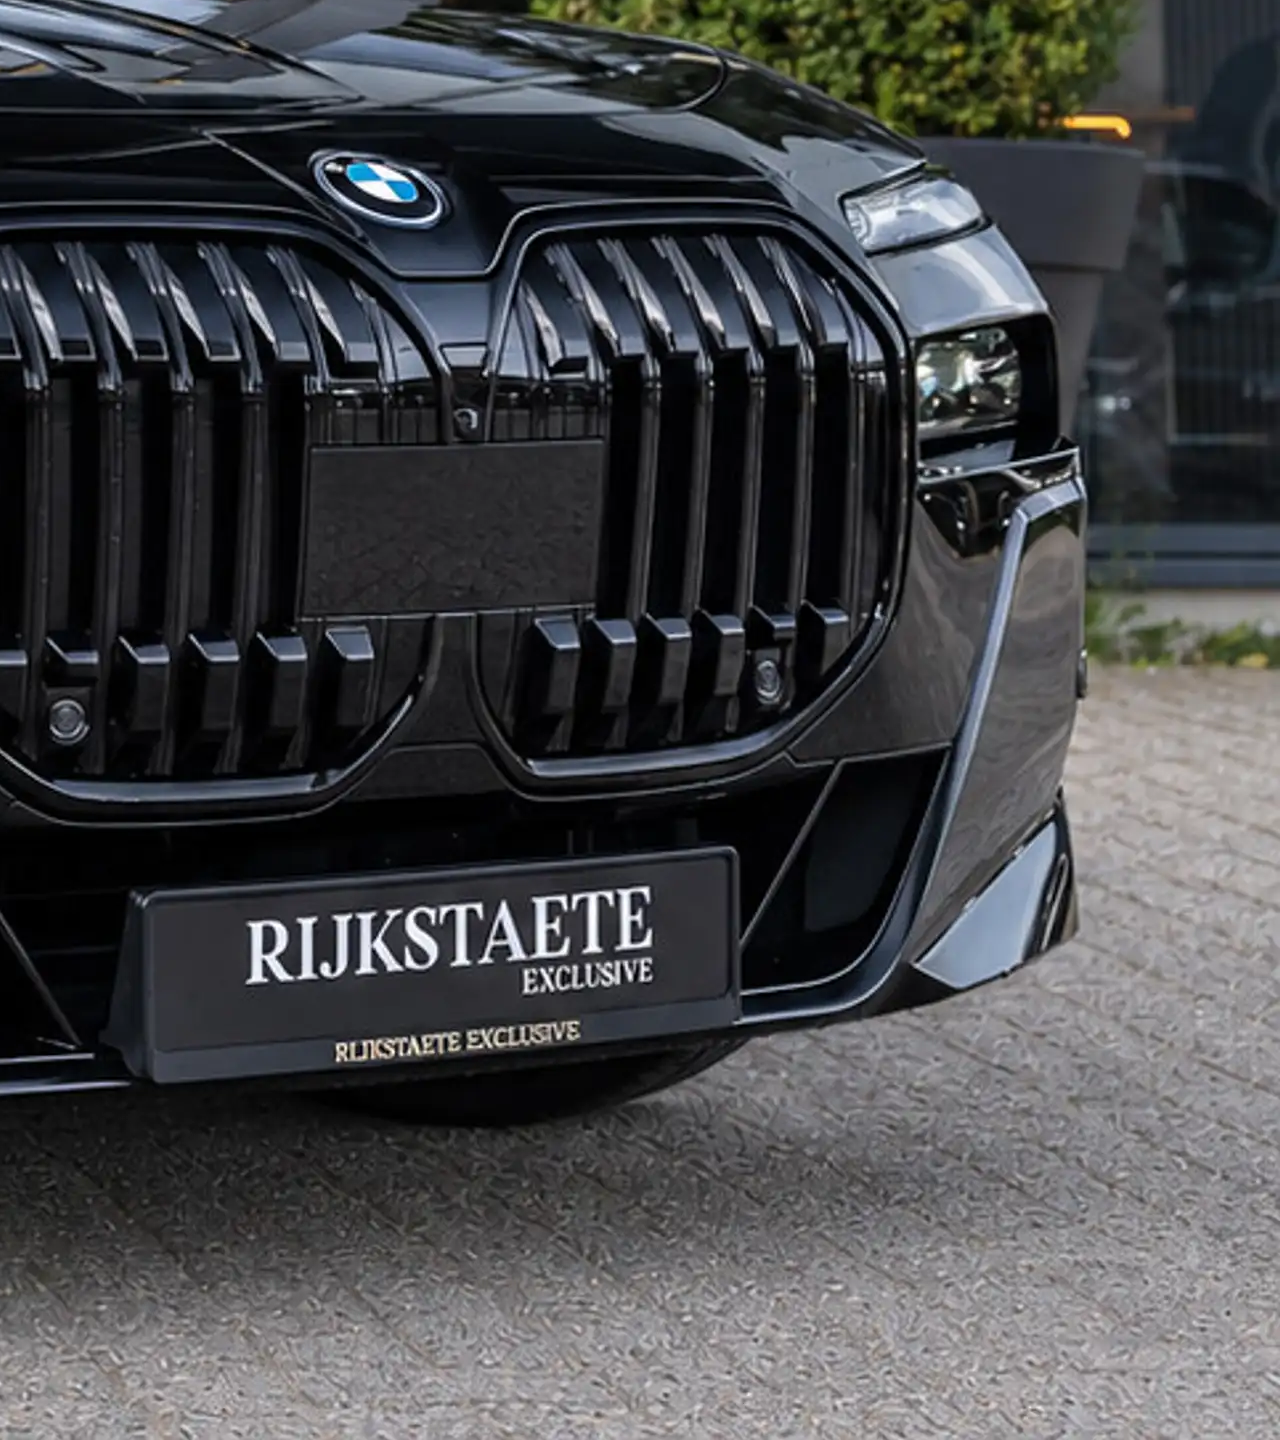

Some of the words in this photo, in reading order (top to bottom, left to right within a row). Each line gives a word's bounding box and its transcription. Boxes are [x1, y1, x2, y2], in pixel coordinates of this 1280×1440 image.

[245, 886, 653, 986] RIJKSTAETE
[522, 957, 653, 996] EXCLUSIVE
[466, 1020, 581, 1050] EXCLUSIVE
